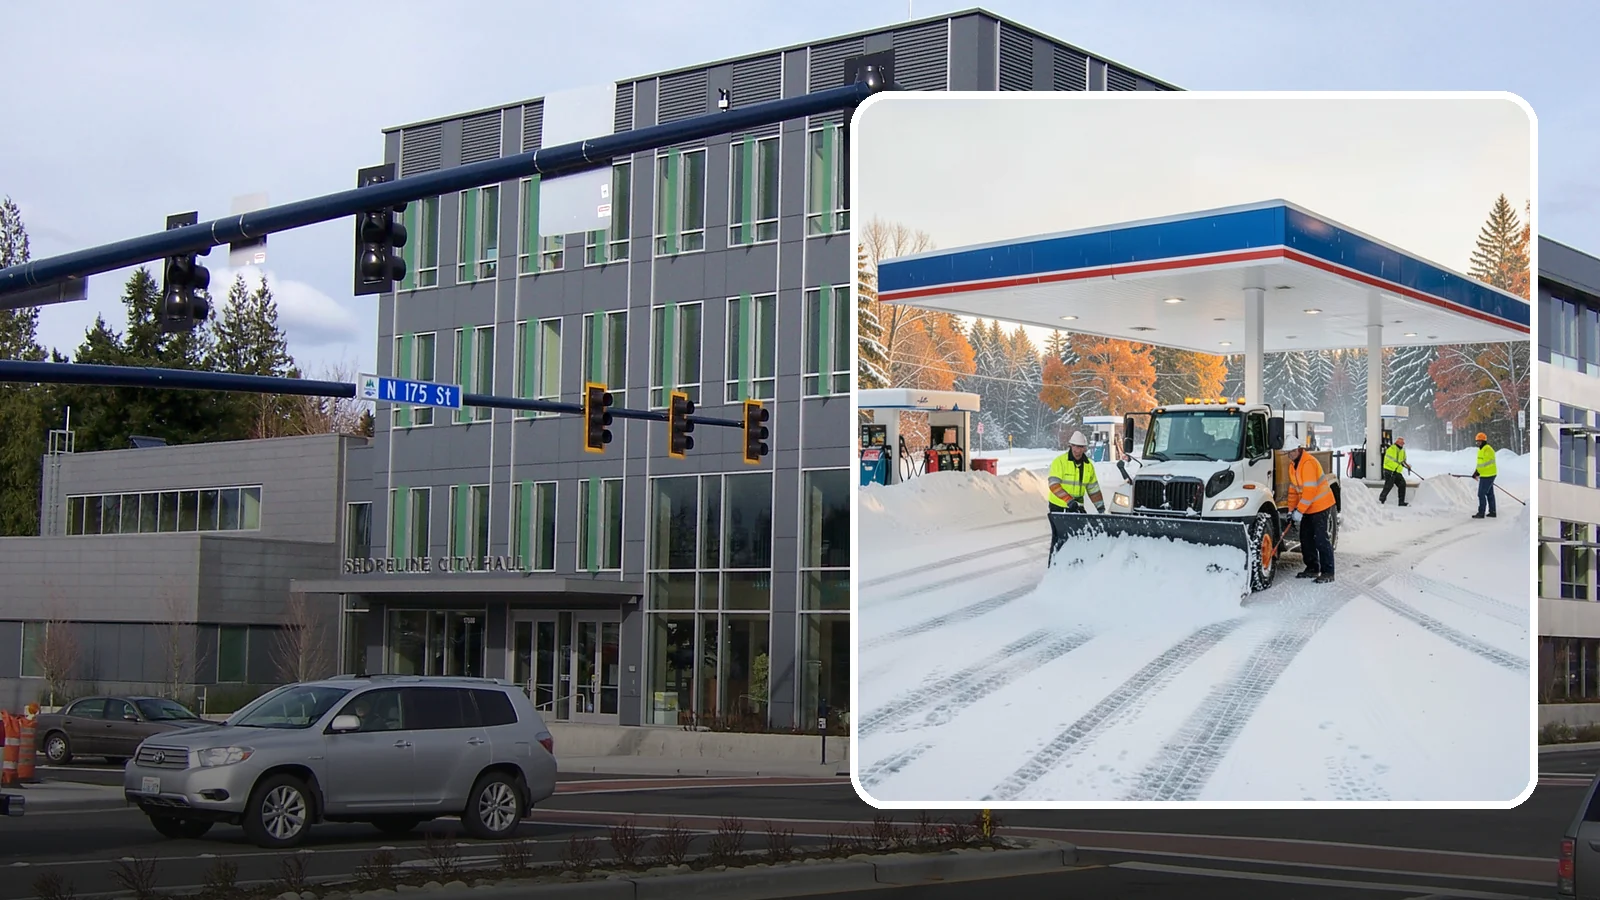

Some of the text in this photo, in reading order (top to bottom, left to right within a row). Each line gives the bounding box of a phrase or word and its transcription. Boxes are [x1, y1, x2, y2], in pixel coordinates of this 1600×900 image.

[387, 380, 451, 406] N 175 St
[344, 555, 526, 574] SHORELINE CITY HALL
